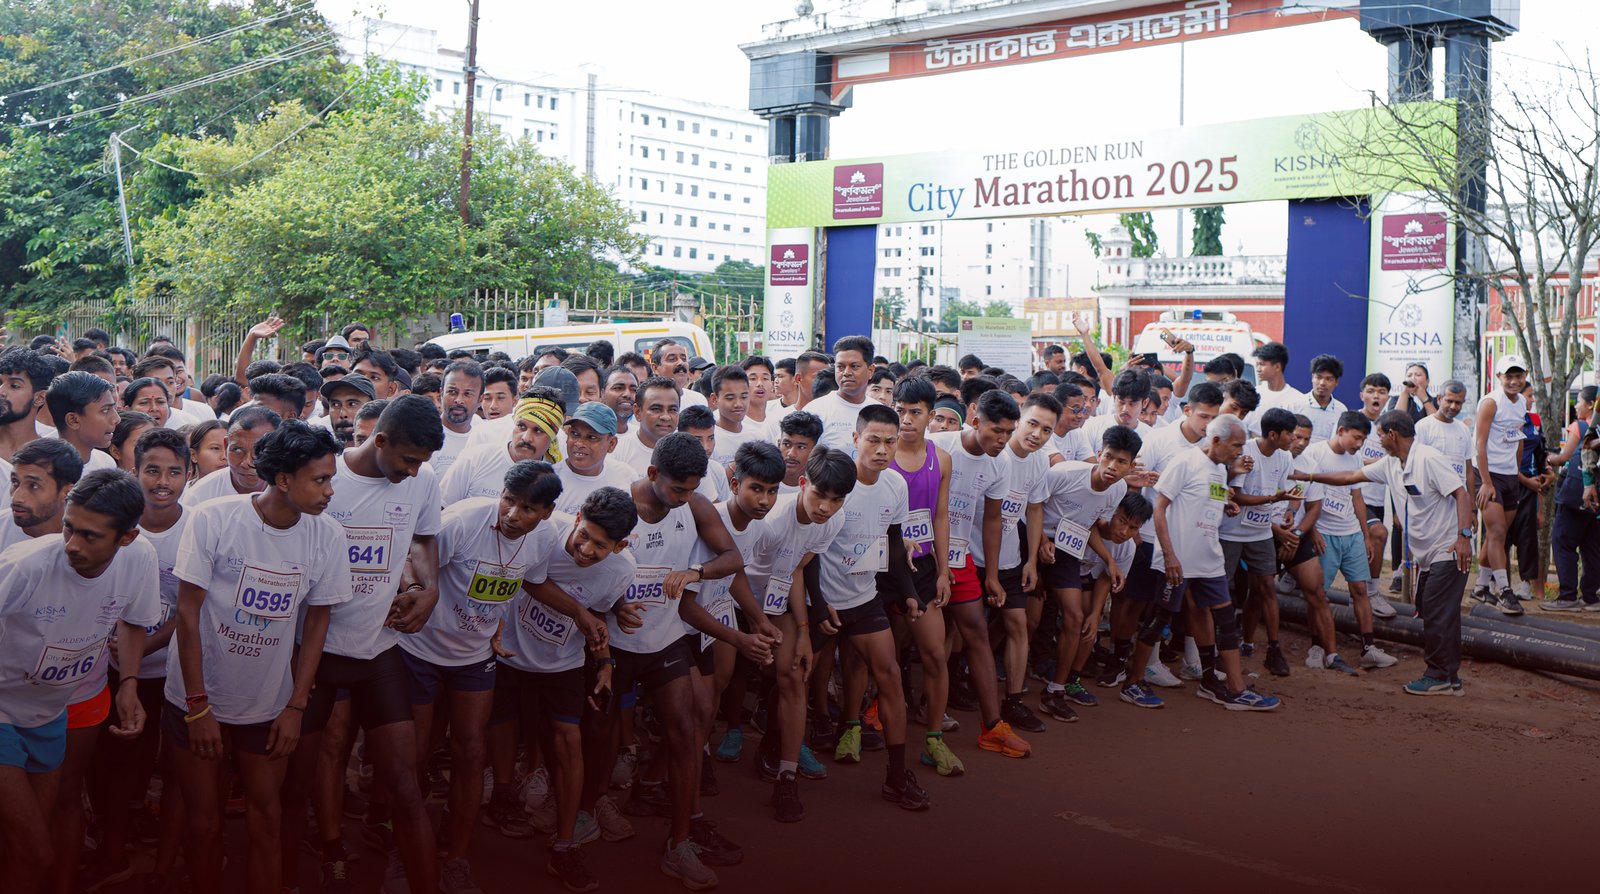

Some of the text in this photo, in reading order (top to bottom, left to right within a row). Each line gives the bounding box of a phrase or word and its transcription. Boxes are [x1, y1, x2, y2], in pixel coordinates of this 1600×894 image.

[924, 30, 1057, 70] উমাকান্ত
[983, 140, 1144, 172] THE GOLDEN RUN
[1274, 153, 1341, 173] KISNA
[908, 155, 1239, 219] City Marathon 2025
[783, 292, 793, 305] &
[768, 331, 805, 341] KISNA
[1216, 334, 1233, 343] CARE
[1379, 332, 1442, 346] KISNA
[1200, 344, 1225, 353] SERVICE
[1002, 500, 1022, 513] 053
[948, 511, 972, 521] rathon
[647, 531, 663, 542] TATA
[1058, 531, 1083, 551] 0199
[645, 540, 665, 550] MOTORS
[948, 549, 961, 561] 81
[257, 577, 287, 588] Marathon
[475, 577, 518, 597] 0180
[626, 582, 664, 600] 0555
[242, 587, 293, 613] 0595
[529, 605, 567, 639] 0052
[217, 622, 280, 647] Marathon
[228, 642, 262, 658] 2025
[40, 655, 95, 681] 0616
